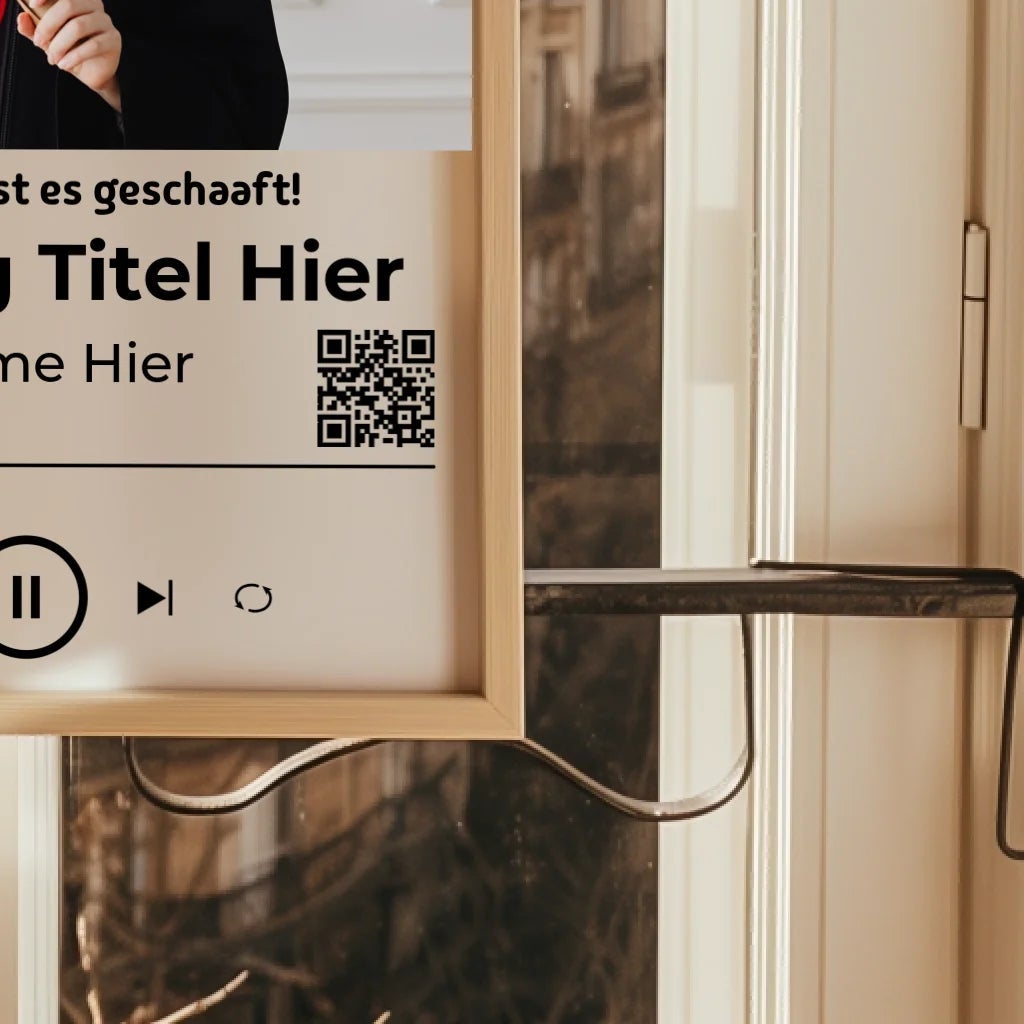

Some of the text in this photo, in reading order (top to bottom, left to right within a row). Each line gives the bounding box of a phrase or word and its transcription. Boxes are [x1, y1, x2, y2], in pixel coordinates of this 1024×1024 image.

[40, 179, 82, 206] es
[93, 170, 301, 216] geschaaft!
[37, 237, 211, 302] Titel
[242, 237, 405, 302] Hier
[86, 340, 194, 383] Hier
